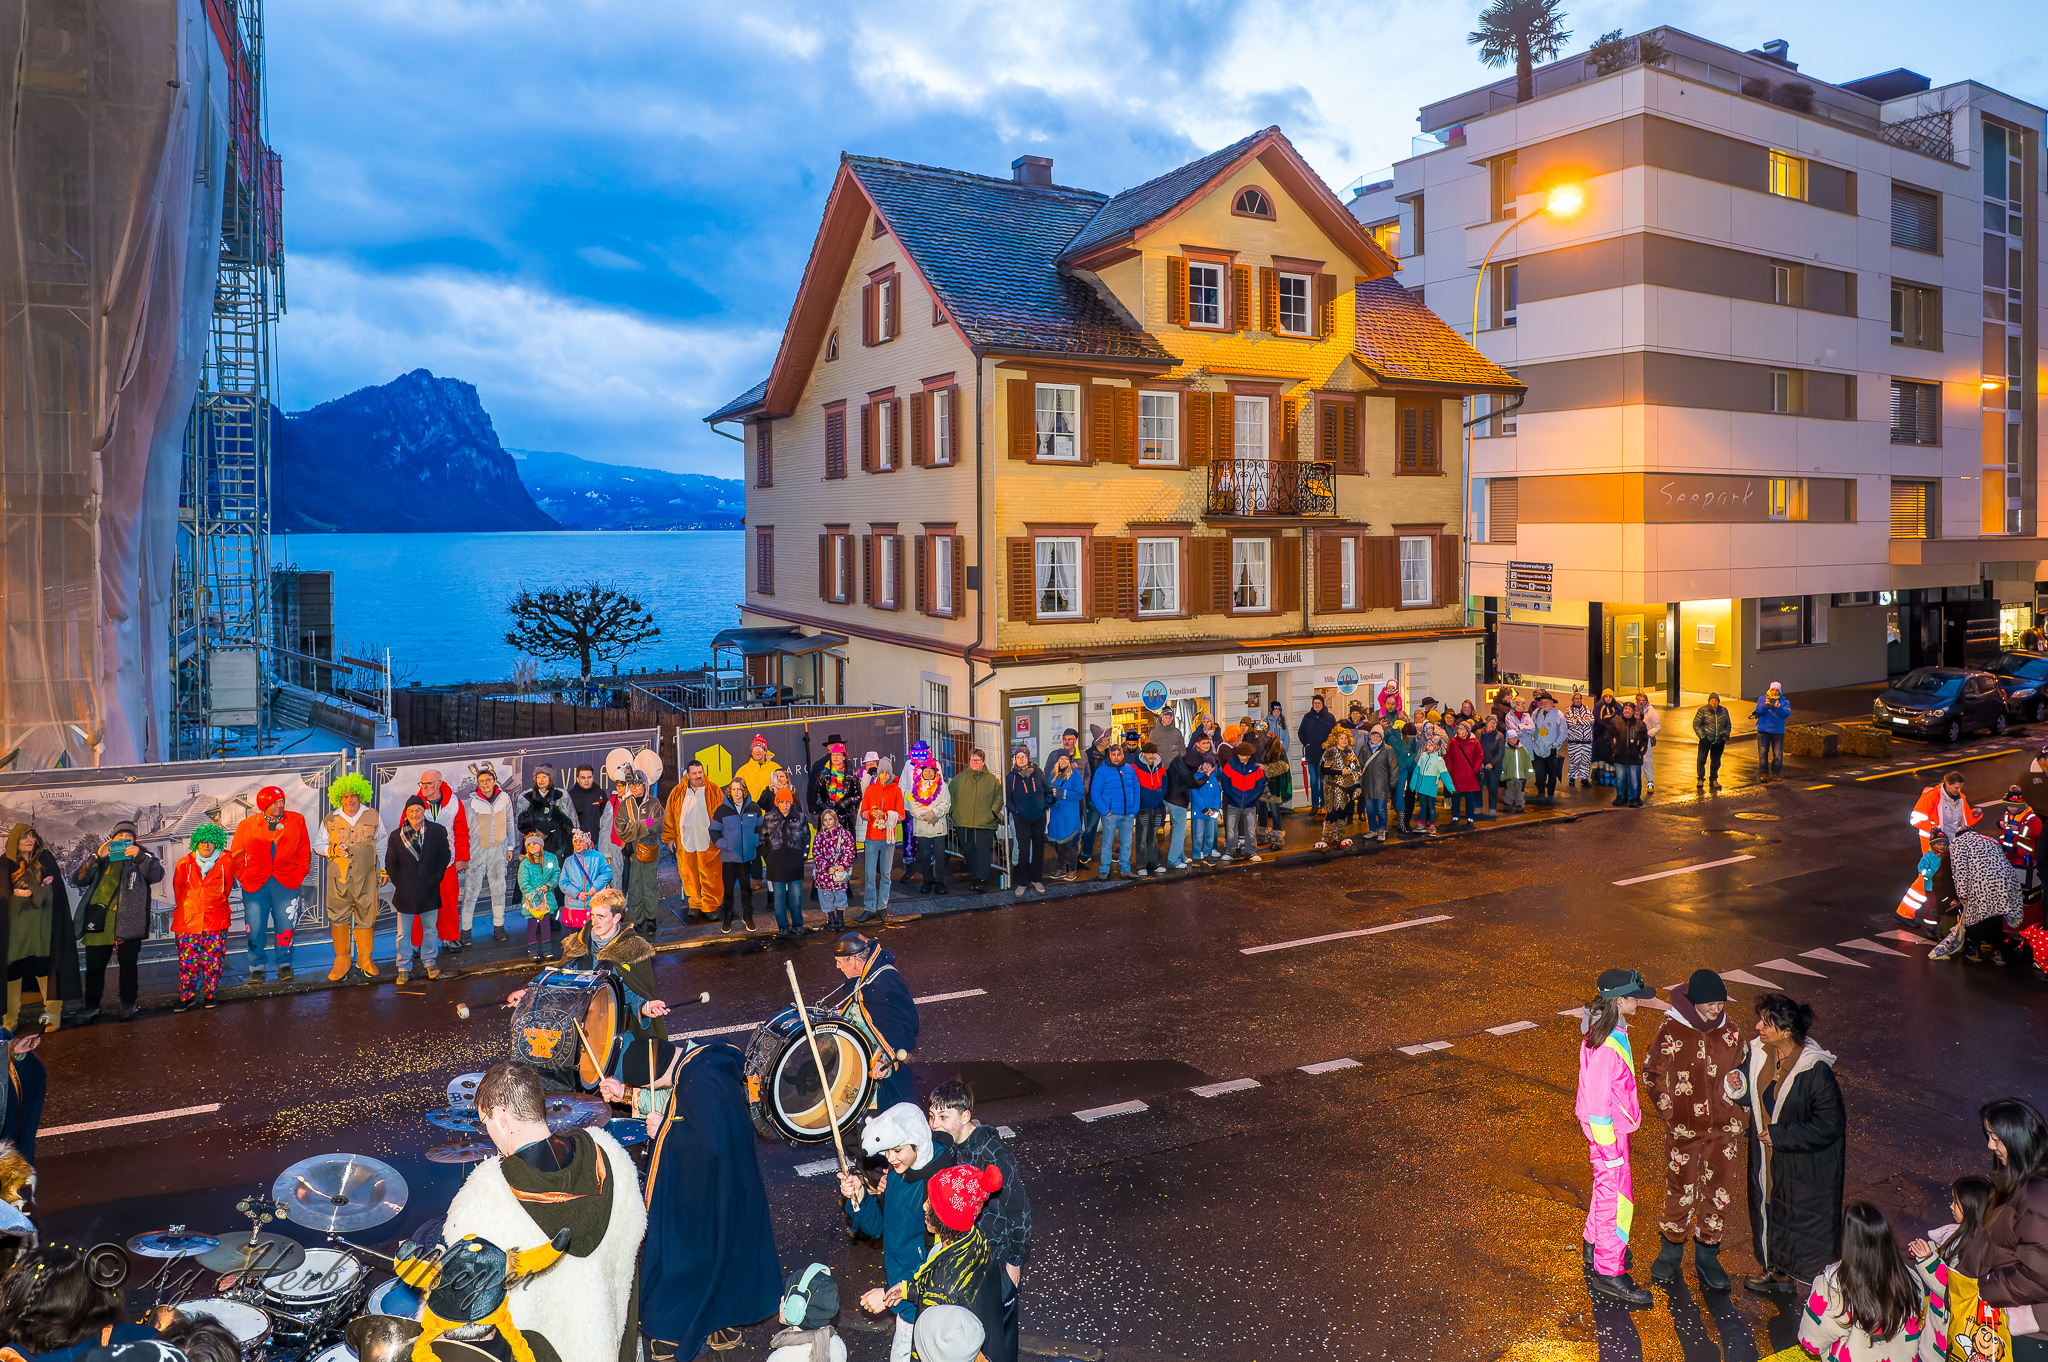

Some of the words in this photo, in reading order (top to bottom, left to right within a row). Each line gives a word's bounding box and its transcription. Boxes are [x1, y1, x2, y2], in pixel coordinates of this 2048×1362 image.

[1323, 675, 1336, 683] Villa
[1126, 690, 1140, 699] Villa
[1145, 688, 1164, 703] VK
[1169, 686, 1197, 696] Kapellmatt
